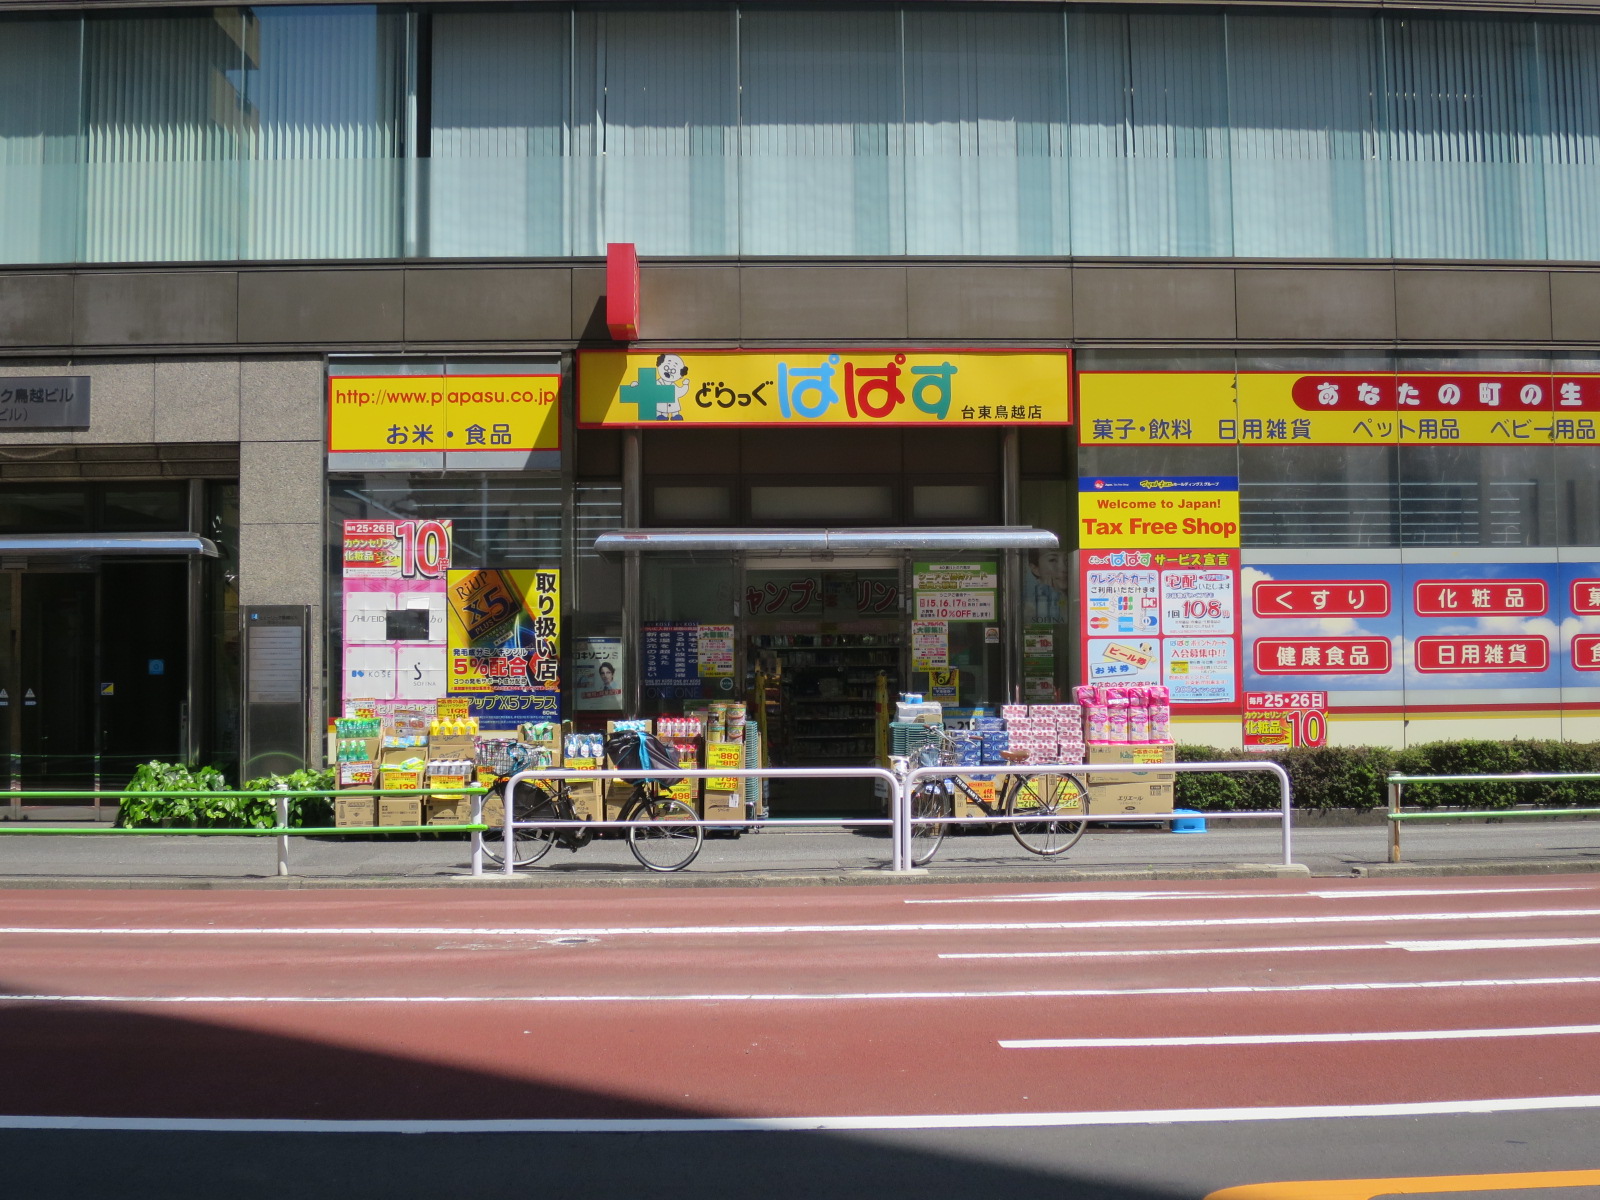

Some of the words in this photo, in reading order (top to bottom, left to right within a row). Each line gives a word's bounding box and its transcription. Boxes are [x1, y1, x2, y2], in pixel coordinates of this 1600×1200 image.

[695, 381, 774, 409] どらっぐ
[777, 353, 958, 421] ぱぱす
[961, 404, 1043, 420] 台東鳥越店
[387, 423, 512, 446] お米・食品
[1092, 418, 1193, 440] 菓子・飲料
[1218, 418, 1312, 440] 日用雑貨
[1353, 417, 1460, 440] ペット用品
[1490, 418, 1596, 440] ベビー用品
[1097, 499, 1157, 509] Welcome
[1161, 500, 1174, 508] to
[1178, 499, 1221, 511] Japan!
[1082, 518, 1123, 535] Tax
[1129, 518, 1178, 535] Free
[1182, 518, 1237, 538] Shop
[1110, 551, 1152, 567] ぱぱす
[1154, 553, 1230, 567] サービス宣言
[1090, 574, 1156, 584] クレジットカード
[1090, 586, 1156, 594] ご利用いただけます
[1275, 589, 1366, 610] くすり
[1438, 588, 1525, 609] 化粧品
[350, 614, 387, 622] SHISEID
[535, 572, 558, 682] 取り扱い店
[1276, 645, 1370, 667] 健康食品
[1438, 643, 1528, 665] 日用雑貨
[453, 657, 528, 678] 5%配合
[452, 695, 558, 711] アップX5プラス
[1245, 720, 1282, 735] 化粧品
[719, 752, 739, 760] 880
